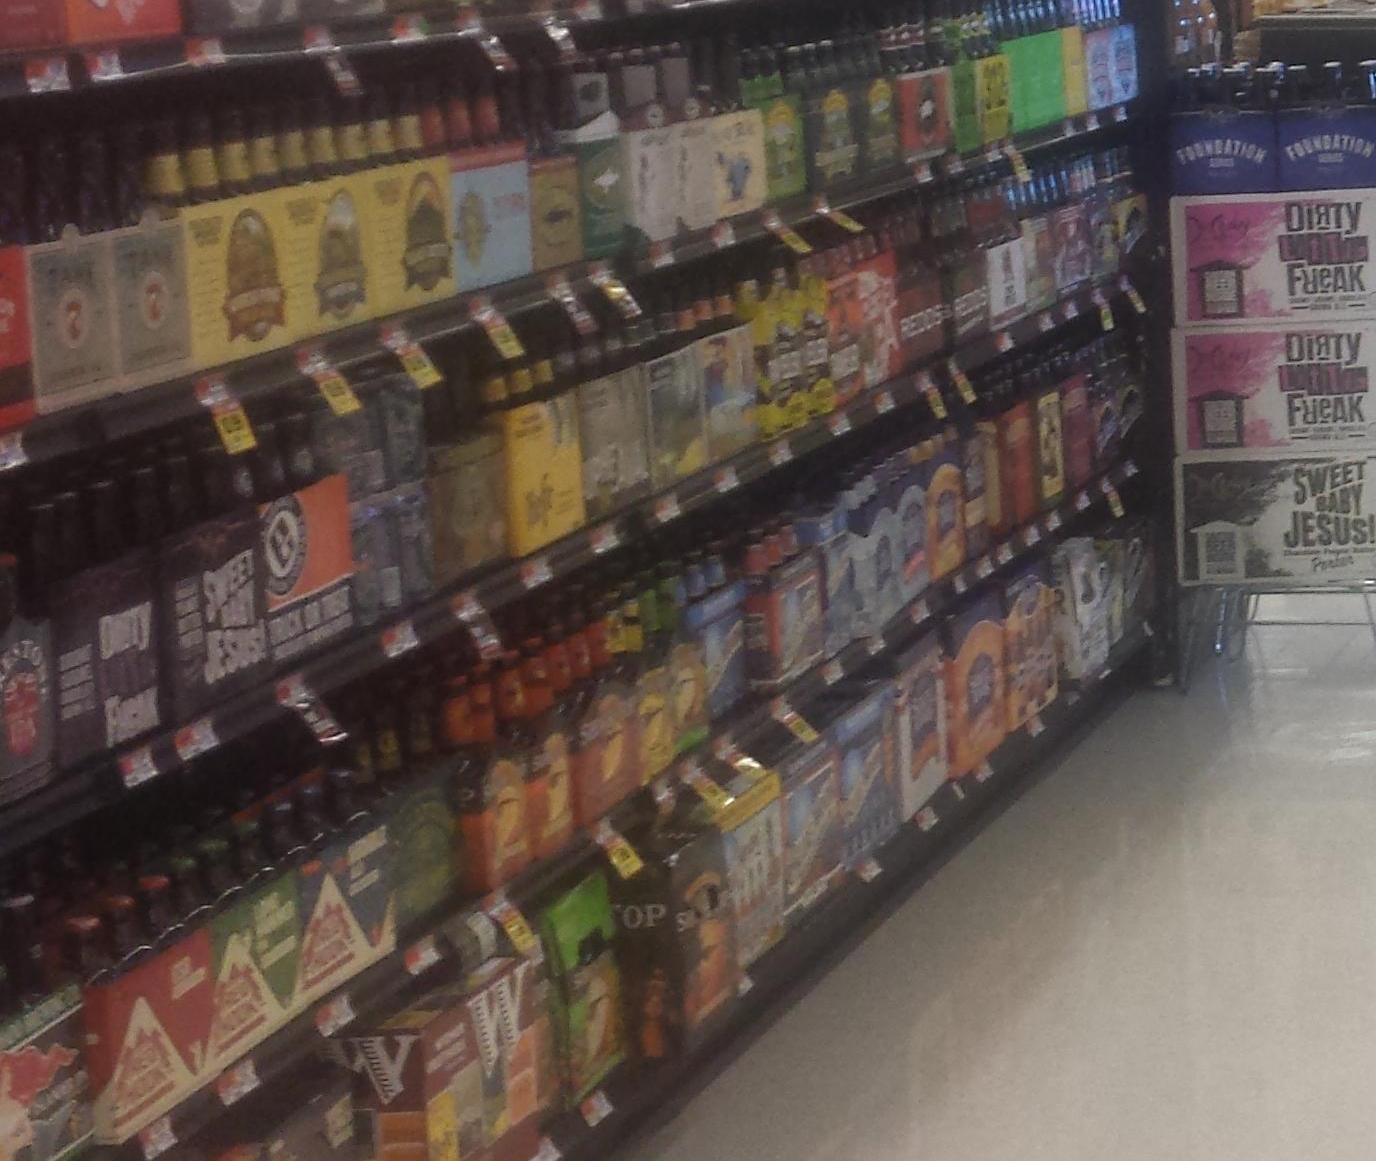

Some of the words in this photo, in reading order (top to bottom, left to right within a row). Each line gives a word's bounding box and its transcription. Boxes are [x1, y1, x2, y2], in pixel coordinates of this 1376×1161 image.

[1176, 138, 1268, 164] FOUNDATION
[1285, 133, 1375, 161] FOUNDATION
[1293, 461, 1367, 505] SWEET
[1283, 511, 1376, 549] JESUS!
